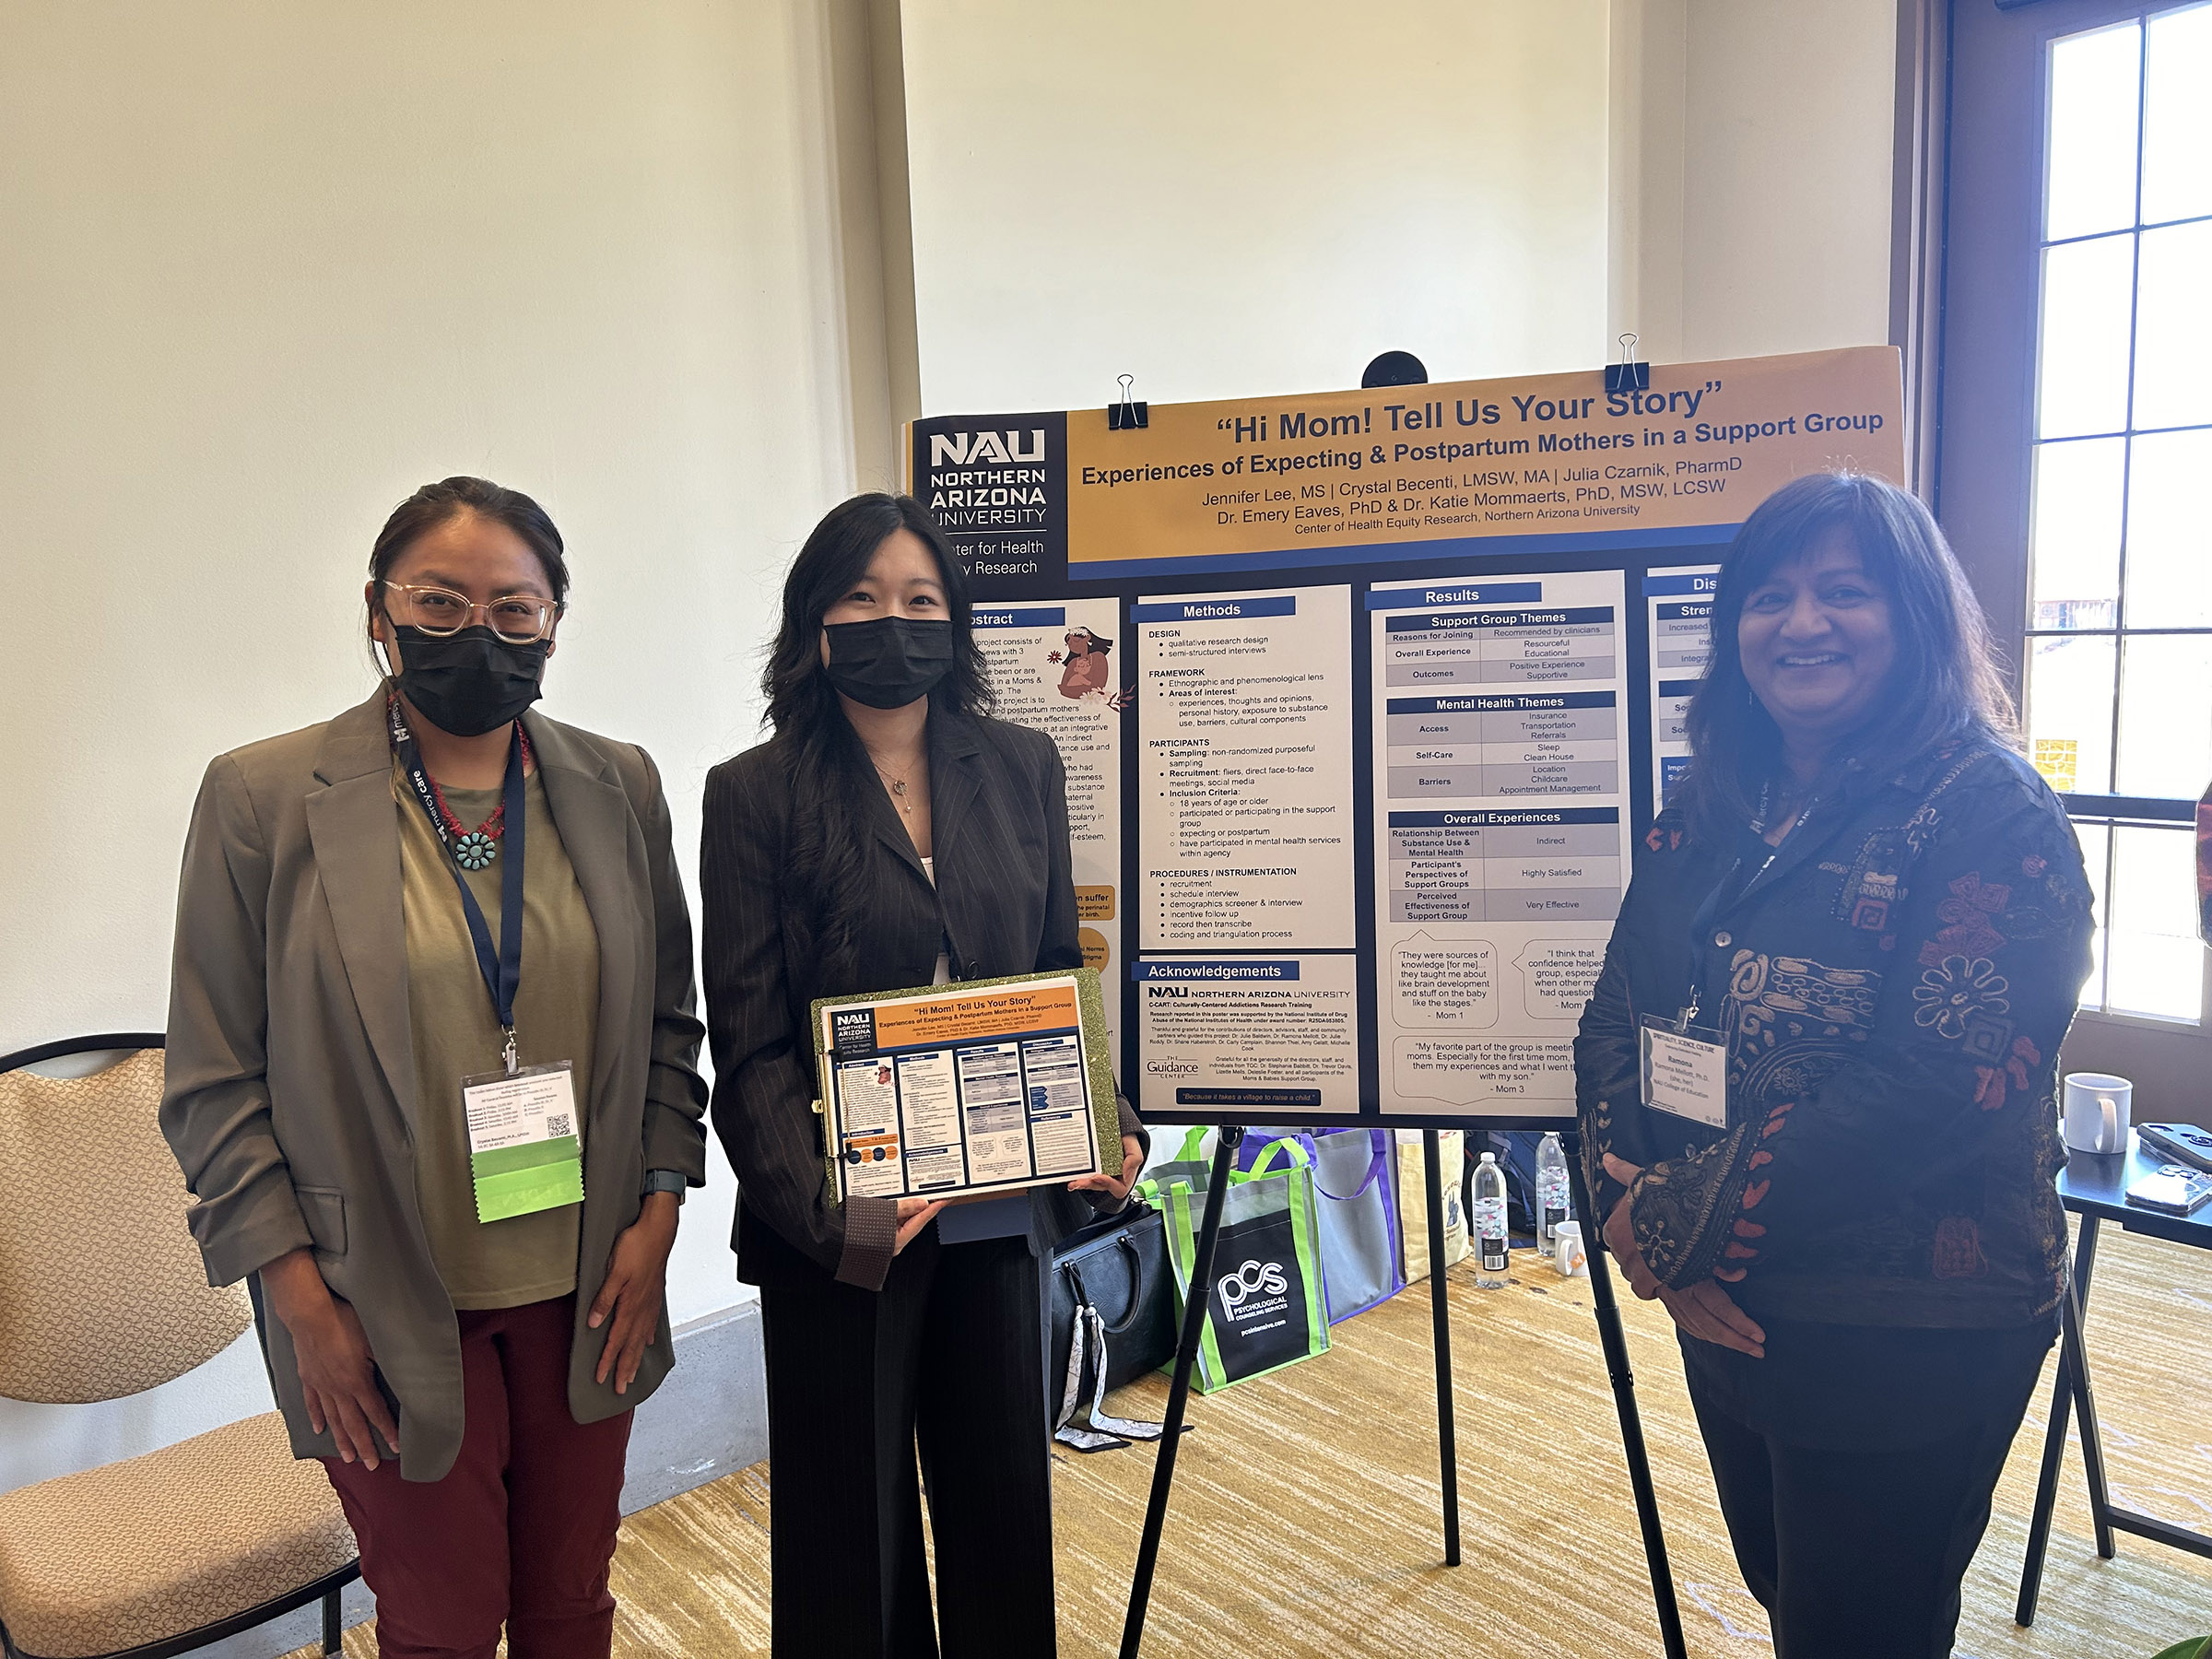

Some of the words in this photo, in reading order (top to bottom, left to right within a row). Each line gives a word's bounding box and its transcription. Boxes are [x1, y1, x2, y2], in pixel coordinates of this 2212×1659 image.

[1280, 407, 1371, 441] Mom!
[1384, 403, 1443, 431] Tell
[1456, 399, 1501, 428] Us
[1512, 394, 1595, 422] Your
[930, 429, 1044, 466] NAU
[1083, 463, 1214, 486] Experiences
[1222, 455, 1243, 475] of
[1251, 449, 1361, 475] Expecting
[1370, 445, 1386, 464] &
[1394, 438, 1529, 463] Postpartum
[1538, 432, 1634, 452] Mothers
[1643, 428, 1664, 446] in
[1673, 429, 1686, 443] a
[1695, 417, 1795, 443] Support
[1805, 413, 1882, 433] Group
[931, 469, 1044, 488] NORTHERN
[1202, 490, 1260, 505] Jennifer
[1265, 488, 1295, 500] Lee,
[1301, 484, 1324, 499] MS
[1339, 479, 1391, 498] Crystal
[1397, 475, 1456, 491] Becenti,
[1464, 471, 1517, 487] LMSW,
[1524, 469, 1549, 483] MA
[1563, 467, 1598, 481] Julia
[1605, 463, 1669, 478] Czarnik,
[1676, 457, 1741, 474] PharmD
[930, 487, 1046, 509] ARIZONA
[1218, 512, 1237, 524] Dr.
[1243, 510, 1289, 523] Emery
[1295, 505, 1344, 522] Eaves,
[1350, 500, 1382, 515] PhD
[1387, 500, 1398, 512] &
[1404, 494, 1427, 511] Dr.
[1430, 490, 1469, 509] Katie
[1473, 489, 1570, 507] Mommaerts,
[1576, 486, 1616, 503] PhD,
[1620, 483, 1666, 499] MSW,
[1674, 478, 1725, 495] LCSW
[1295, 524, 1331, 534] Center
[1334, 521, 1345, 531] of
[1348, 519, 1382, 530] Health
[1387, 517, 1420, 529] Equity
[1424, 512, 1480, 524] Research,
[1485, 511, 1534, 521] Northern
[1536, 508, 1579, 518] Arizona
[1583, 504, 1640, 516] University
[955, 545, 973, 556] ter
[978, 541, 996, 554] for
[1001, 540, 1043, 554] Health
[976, 559, 1037, 574] Research
[1426, 589, 1479, 603] Results
[1184, 604, 1241, 617] Methods
[1681, 606, 1712, 615] Stren
[1431, 616, 1477, 629] Support
[1481, 615, 1517, 628] Group
[1520, 613, 1568, 625] Themes
[1494, 629, 1551, 638] Recommended
[1553, 628, 1562, 637] by
[1564, 627, 1601, 636] clinicians
[1669, 623, 1709, 632] Increased
[1149, 629, 1180, 638] DESIGN
[1524, 639, 1570, 647] Resourceful
[1426, 648, 1470, 656] Experience
[1524, 649, 1569, 657] Educational
[1149, 668, 1205, 677] FRAMEWORK
[1526, 672, 1569, 680] Supportive
[1437, 699, 1474, 709] Mental
[1478, 698, 1513, 708] Health
[1518, 698, 1564, 707] Themes
[1521, 722, 1576, 730] Transportation
[1149, 738, 1209, 747] PARTICIPANTS
[413, 770, 429, 794] care
[1499, 785, 1548, 794] Appointment
[1549, 784, 1602, 794] Management
[423, 794, 441, 824] mercy
[1444, 814, 1485, 823] Overall
[1488, 813, 1560, 824] Experiences
[1393, 830, 1442, 838] Relationship
[1216, 867, 1296, 876] INSTRUMENTATION
[1522, 869, 1546, 877] Highly
[1405, 881, 1437, 890] Support
[1439, 880, 1469, 890] Groups
[1525, 901, 1544, 910] Very
[1407, 912, 1440, 922] Support
[1441, 912, 1467, 921] Group
[1148, 965, 1281, 979] Acknowledgements
[1148, 987, 1188, 997] NAU
[930, 1005, 954, 1016] Mom!
[957, 1003, 972, 1012] Tell
[973, 1002, 985, 1010] Us
[987, 999, 1008, 1008] Your
[837, 1014, 870, 1025] NAU
[838, 1023, 871, 1032] NORTHERN
[838, 1029, 871, 1038] ARIZONA
[838, 1034, 871, 1043] UNIVERSITY
[1147, 1061, 1198, 1075] Guidance
[1218, 1259, 1289, 1324] pcs
[1233, 1296, 1288, 1316] PSYCHOLOGICAL
[1235, 1308, 1265, 1322] COUNSELING
[1265, 1302, 1289, 1314] SERVICES
[1241, 1320, 1288, 1338] pcsintensive.com
